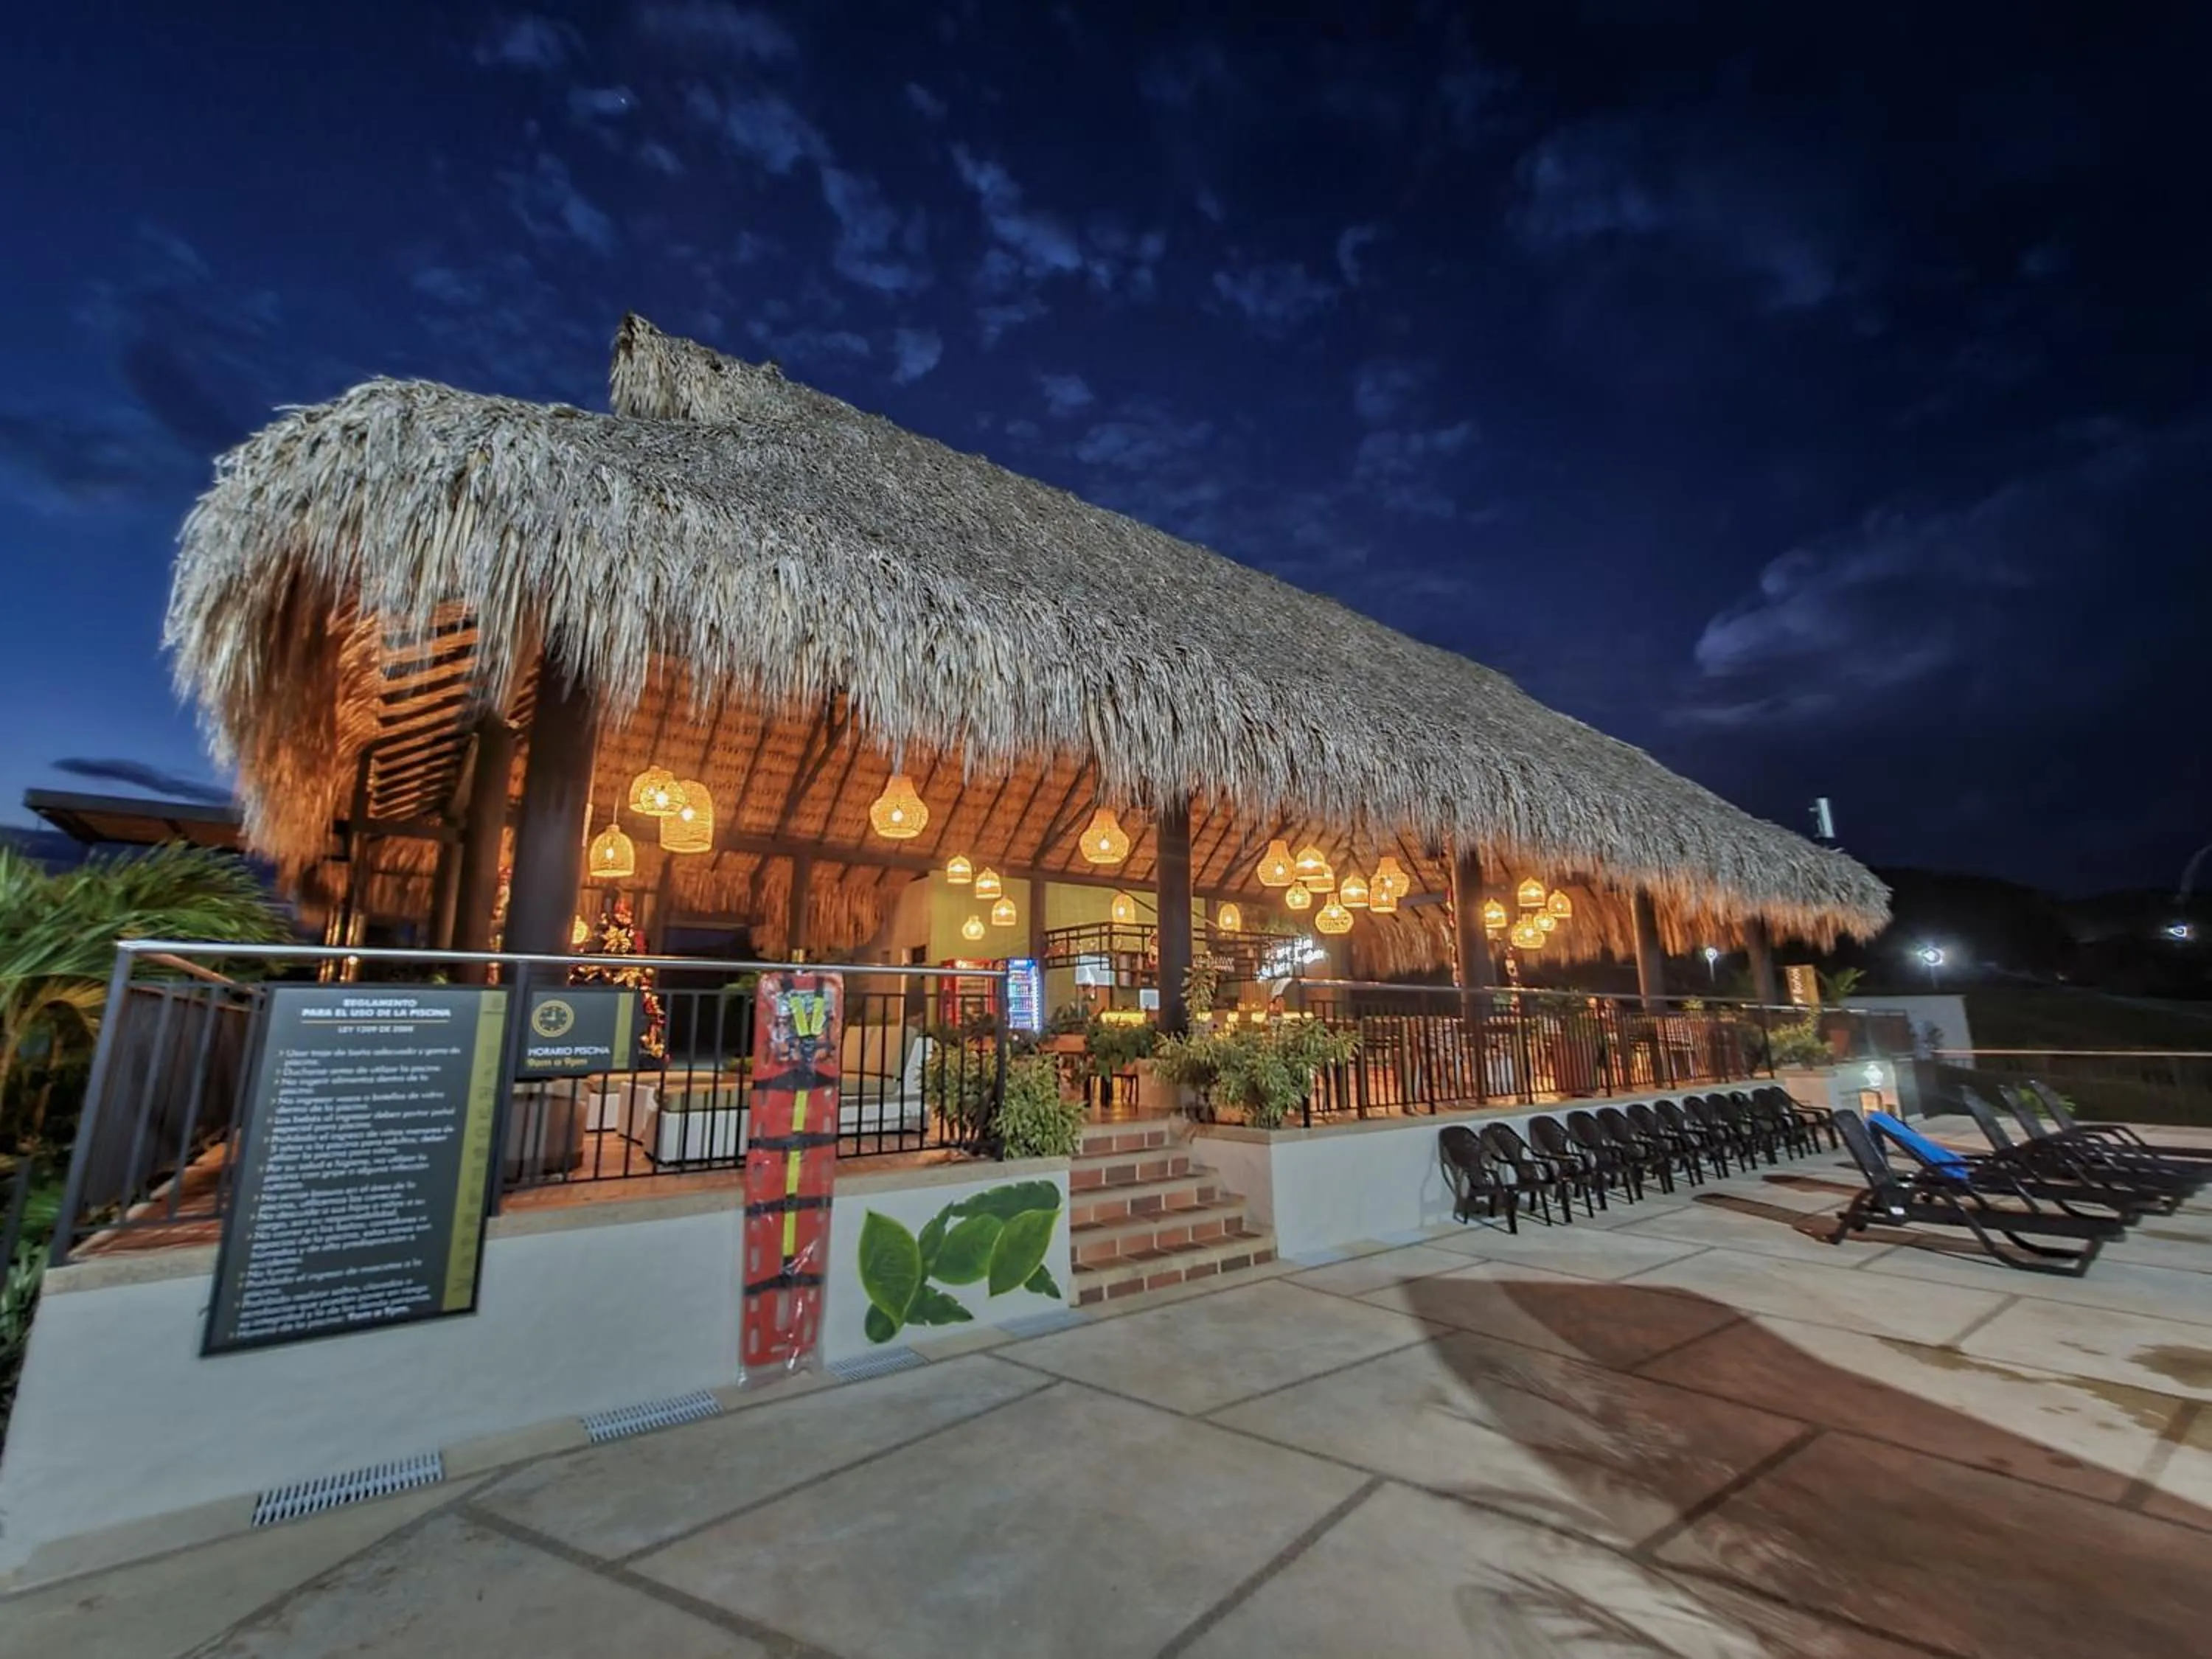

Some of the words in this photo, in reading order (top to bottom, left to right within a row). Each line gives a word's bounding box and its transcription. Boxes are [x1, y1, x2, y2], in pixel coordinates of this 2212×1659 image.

[343, 998, 417, 1007] REGLAMENTO
[301, 1008, 333, 1017] PARA
[335, 1008, 347, 1017] EL
[377, 1009, 391, 1017] DE
[409, 1009, 451, 1017] PISCINA
[337, 1026, 354, 1034] LEY
[527, 1046, 573, 1057] HORARIO
[574, 1046, 611, 1056] PISCINA
[553, 1059, 563, 1067] a
